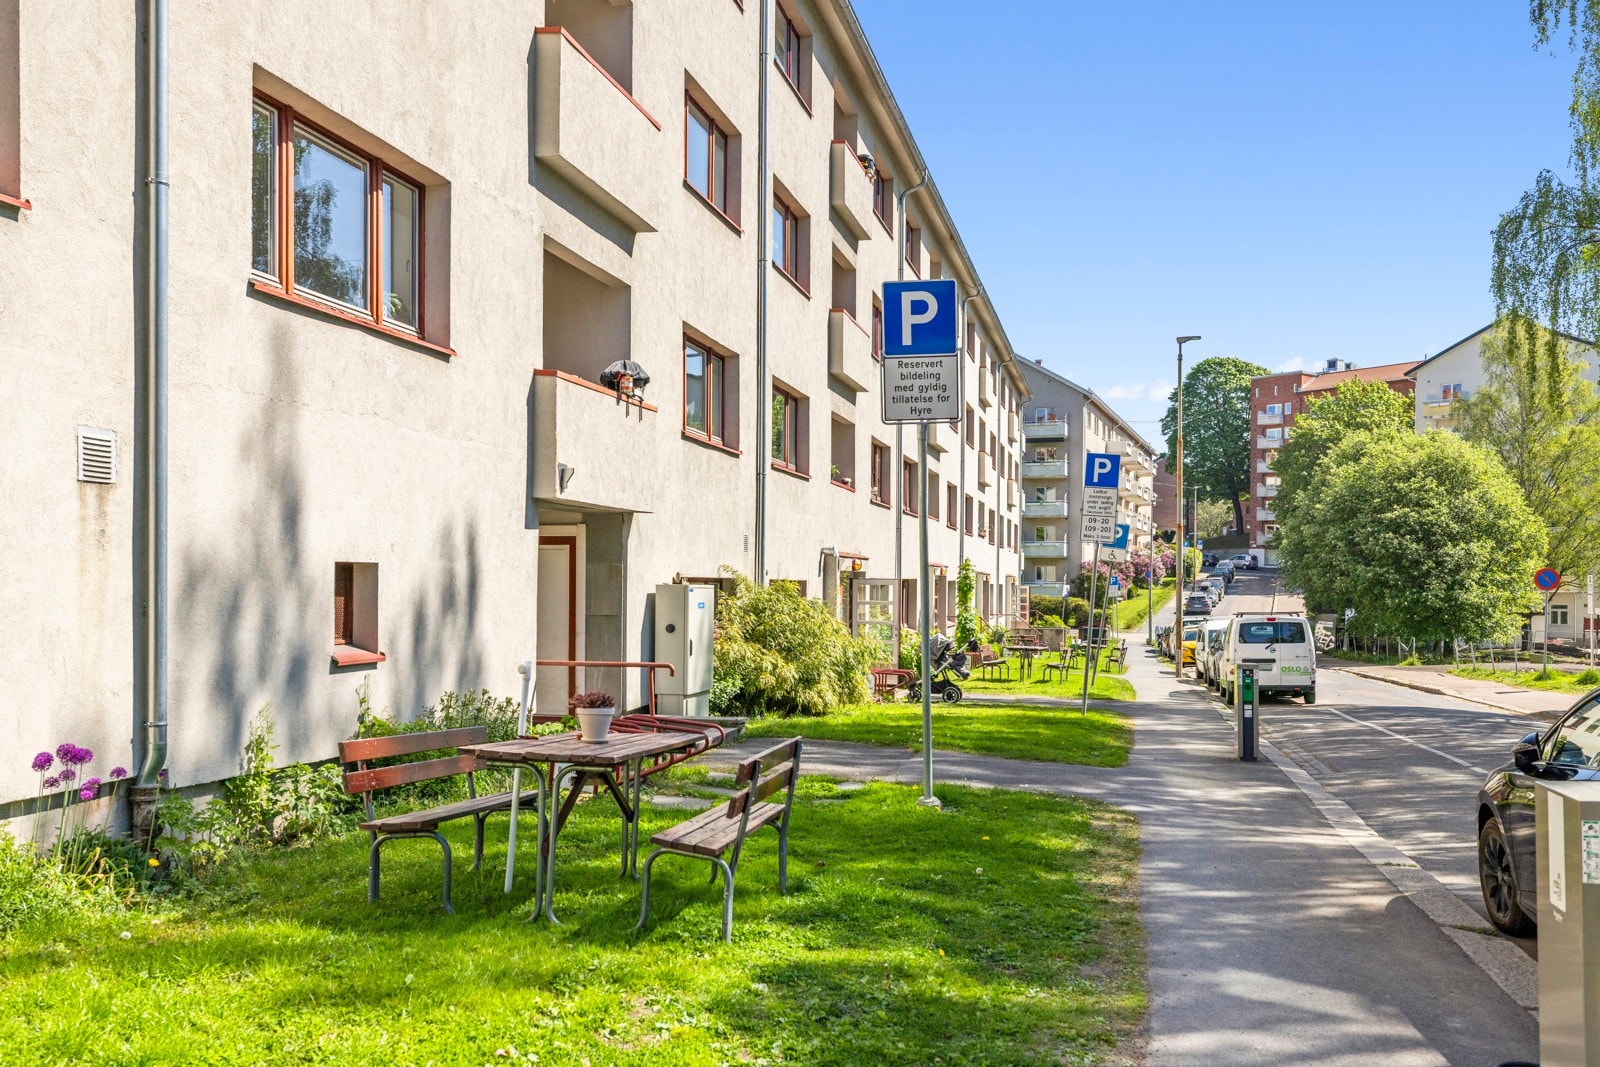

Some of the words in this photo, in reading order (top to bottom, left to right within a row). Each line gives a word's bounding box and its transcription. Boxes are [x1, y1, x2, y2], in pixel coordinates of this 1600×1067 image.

[901, 291, 938, 346] P
[897, 359, 943, 369] Reservert
[900, 371, 941, 381] bildeling
[894, 383, 914, 392] med
[918, 383, 947, 393] gyldig
[892, 394, 933, 404] tillatelse
[937, 393, 950, 402] for
[910, 406, 932, 416] Hyre
[1093, 457, 1112, 483] P
